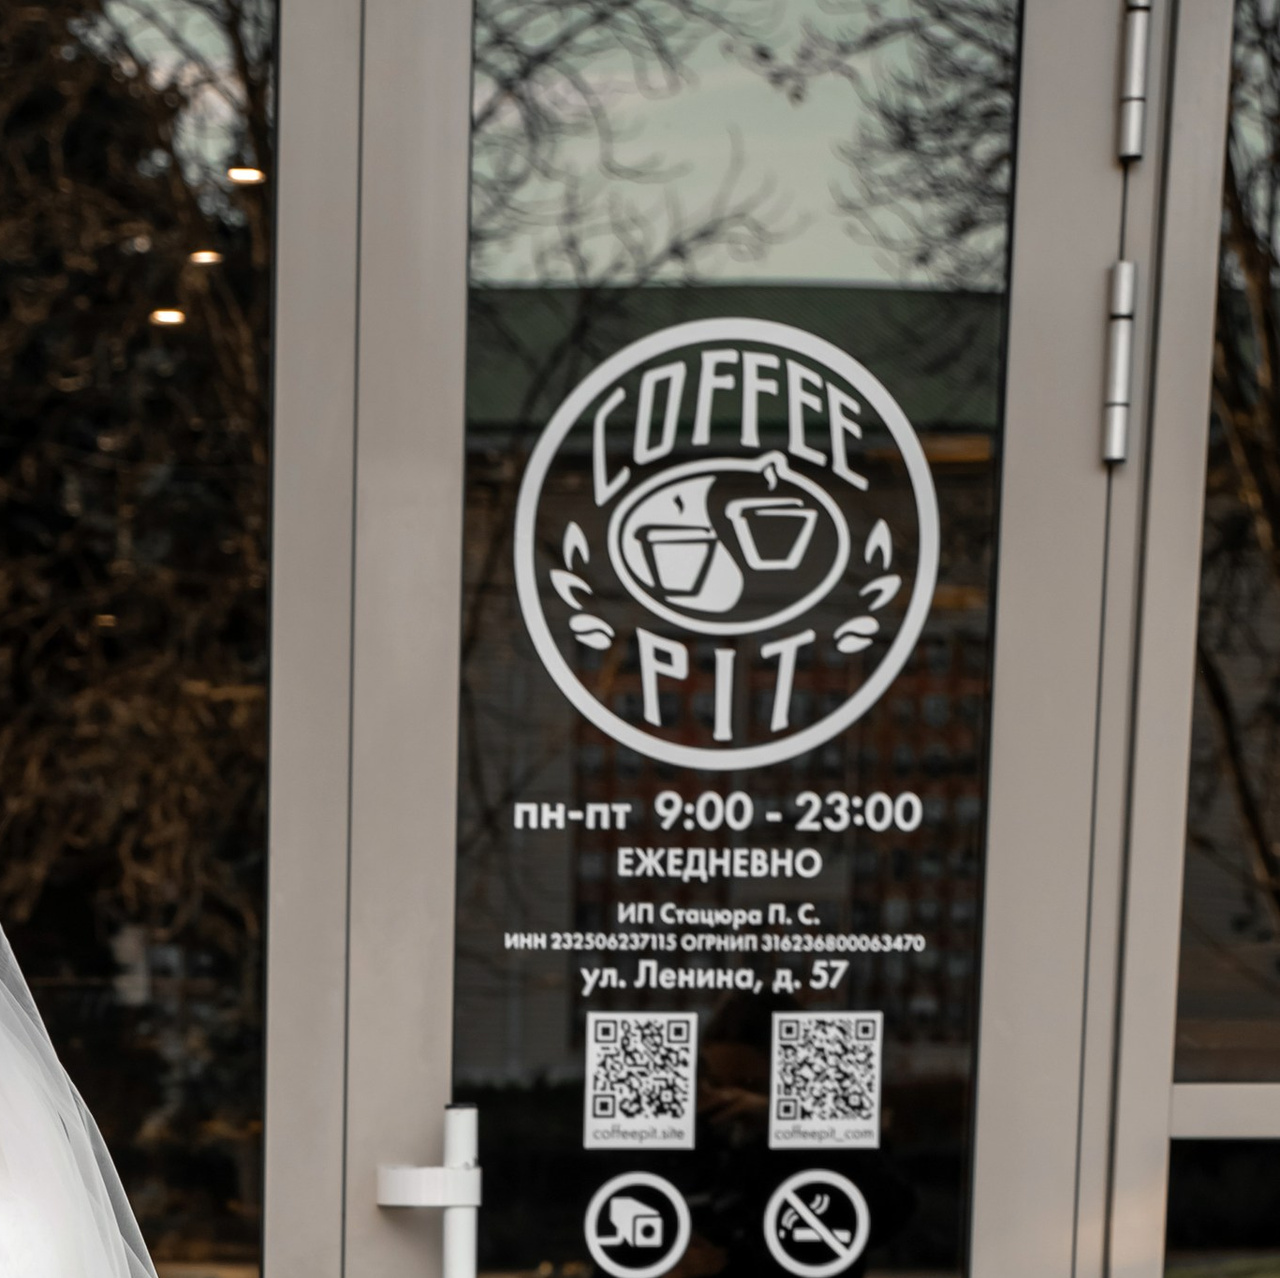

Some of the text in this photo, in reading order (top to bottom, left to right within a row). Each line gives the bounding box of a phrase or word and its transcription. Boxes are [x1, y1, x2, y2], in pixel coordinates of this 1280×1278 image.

[592, 347, 870, 507] COFFEE
[635, 626, 816, 742] PIT
[514, 802, 632, 830] пн-пт
[654, 791, 754, 831] 9:00
[794, 791, 924, 832] 23:00
[618, 847, 822, 883] ЕЖЕДНЕВНО
[617, 902, 821, 931] ИП Стацюра П. С.
[504, 932, 547, 950] ИНН
[680, 934, 758, 951] ОГРНИП
[580, 958, 850, 997] ул. Ленина, д. 57
